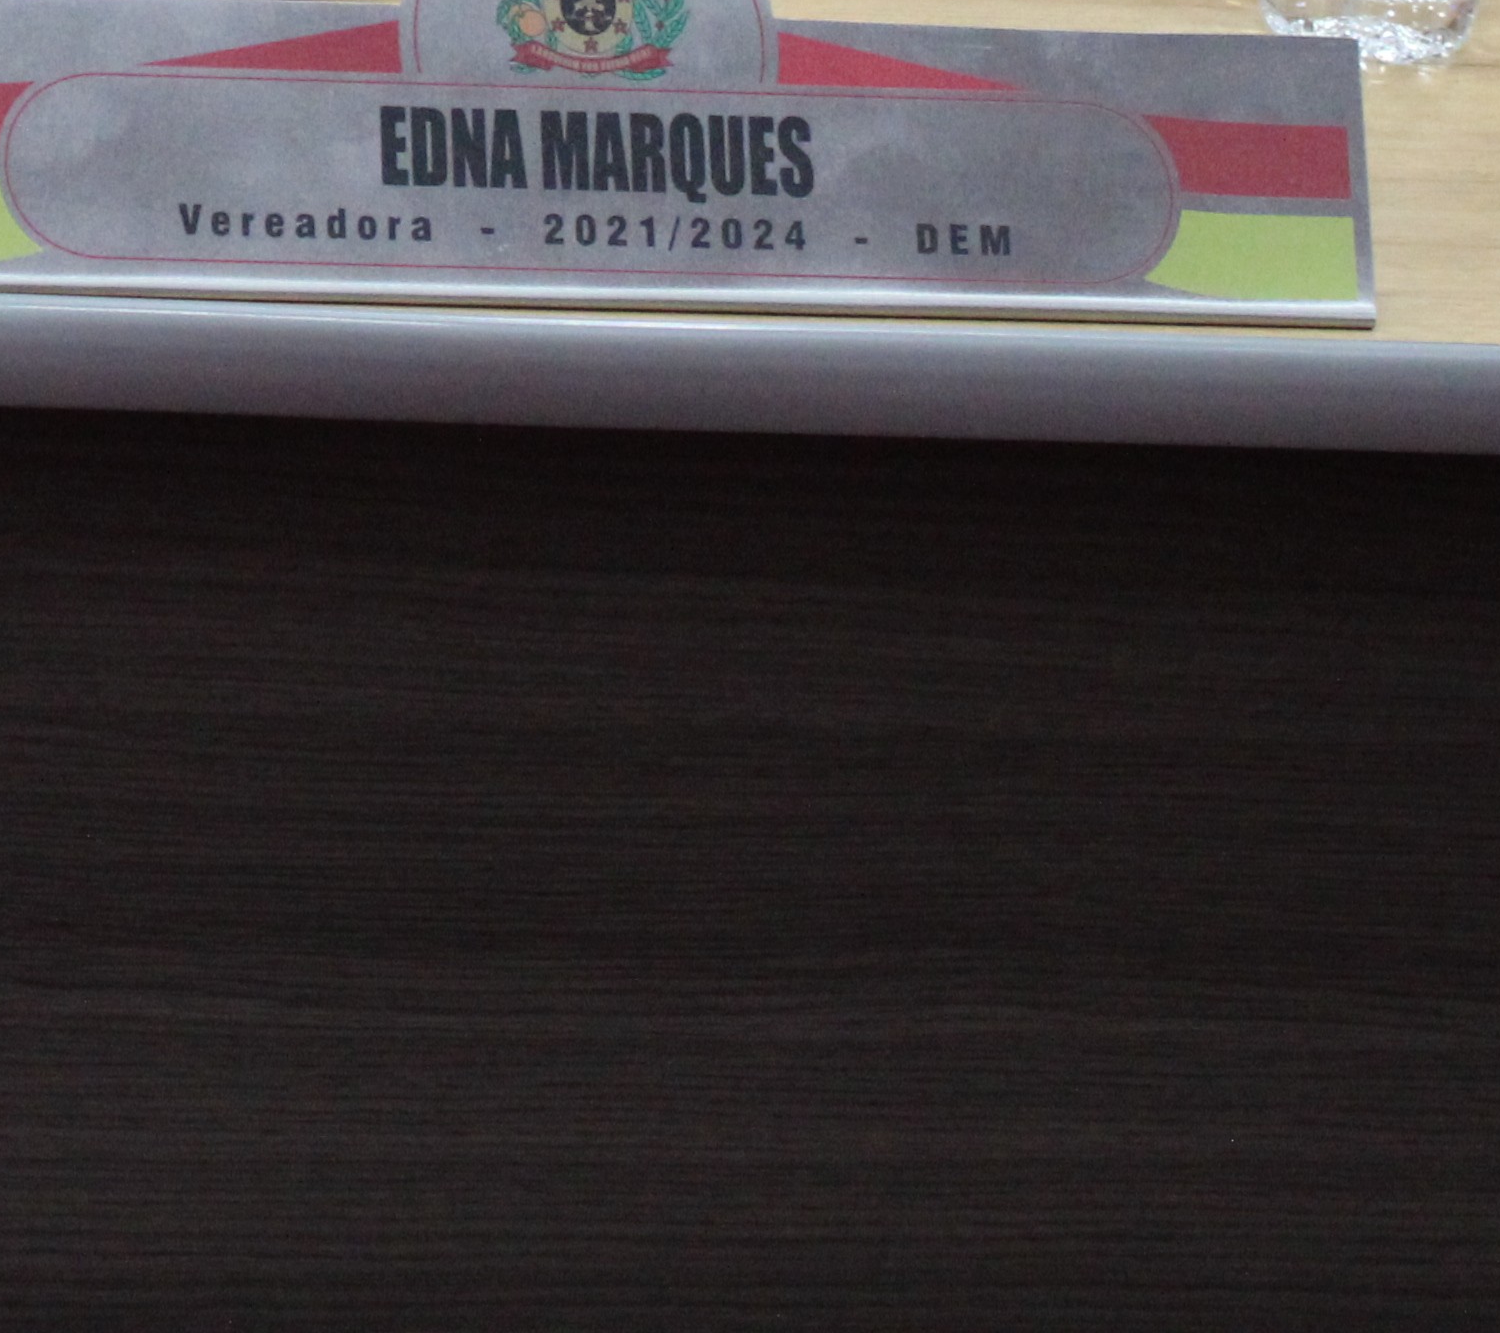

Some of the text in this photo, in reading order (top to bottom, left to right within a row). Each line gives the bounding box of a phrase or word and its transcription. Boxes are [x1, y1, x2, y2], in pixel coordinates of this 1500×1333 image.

[380, 105, 815, 203] EDNA MARQUES
[178, 202, 433, 242] Vereadora
[543, 212, 807, 252] 2021/2024
[916, 222, 1011, 256] DEM
